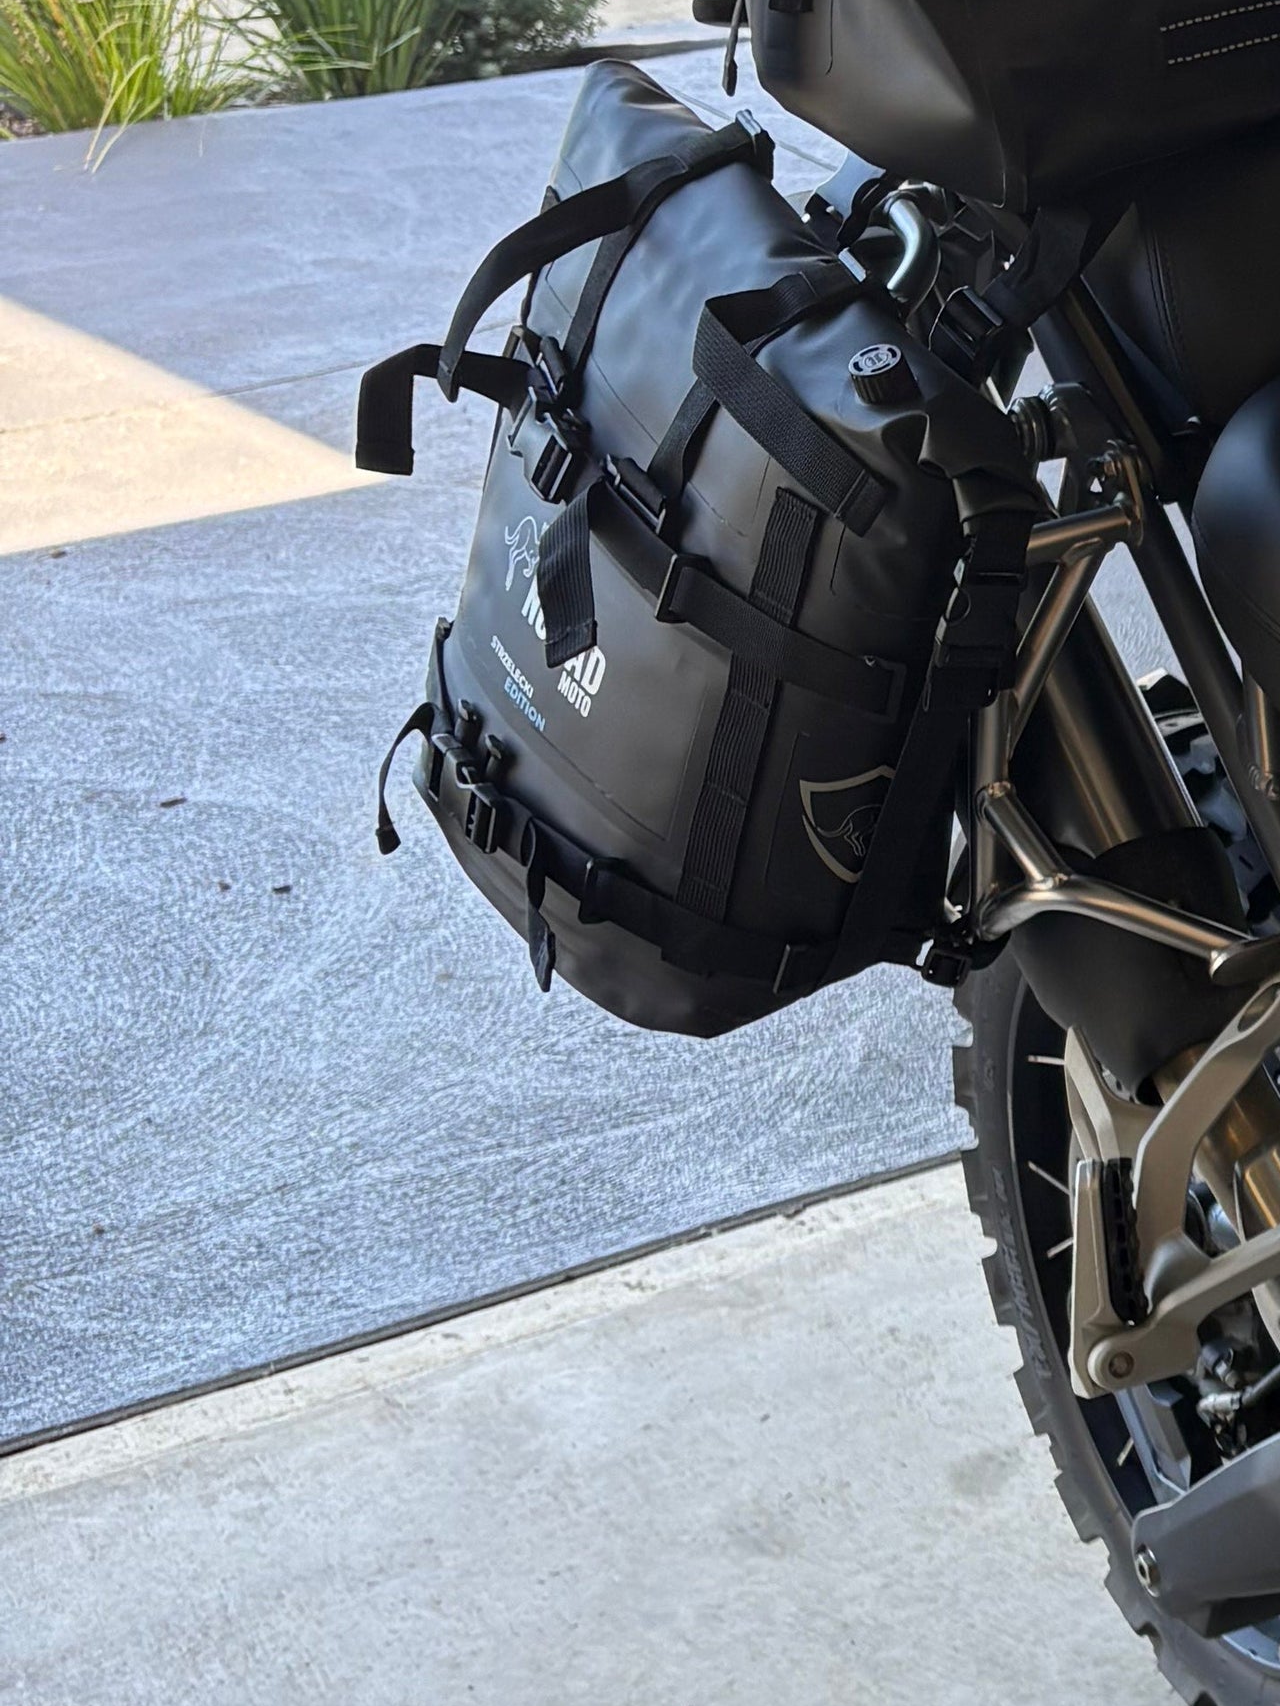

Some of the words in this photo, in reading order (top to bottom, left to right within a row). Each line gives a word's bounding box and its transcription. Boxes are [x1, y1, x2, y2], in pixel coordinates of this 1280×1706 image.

[489, 634, 534, 699] STRZELECKI
[556, 670, 592, 718] MOTO
[503, 676, 547, 733] EDITION
